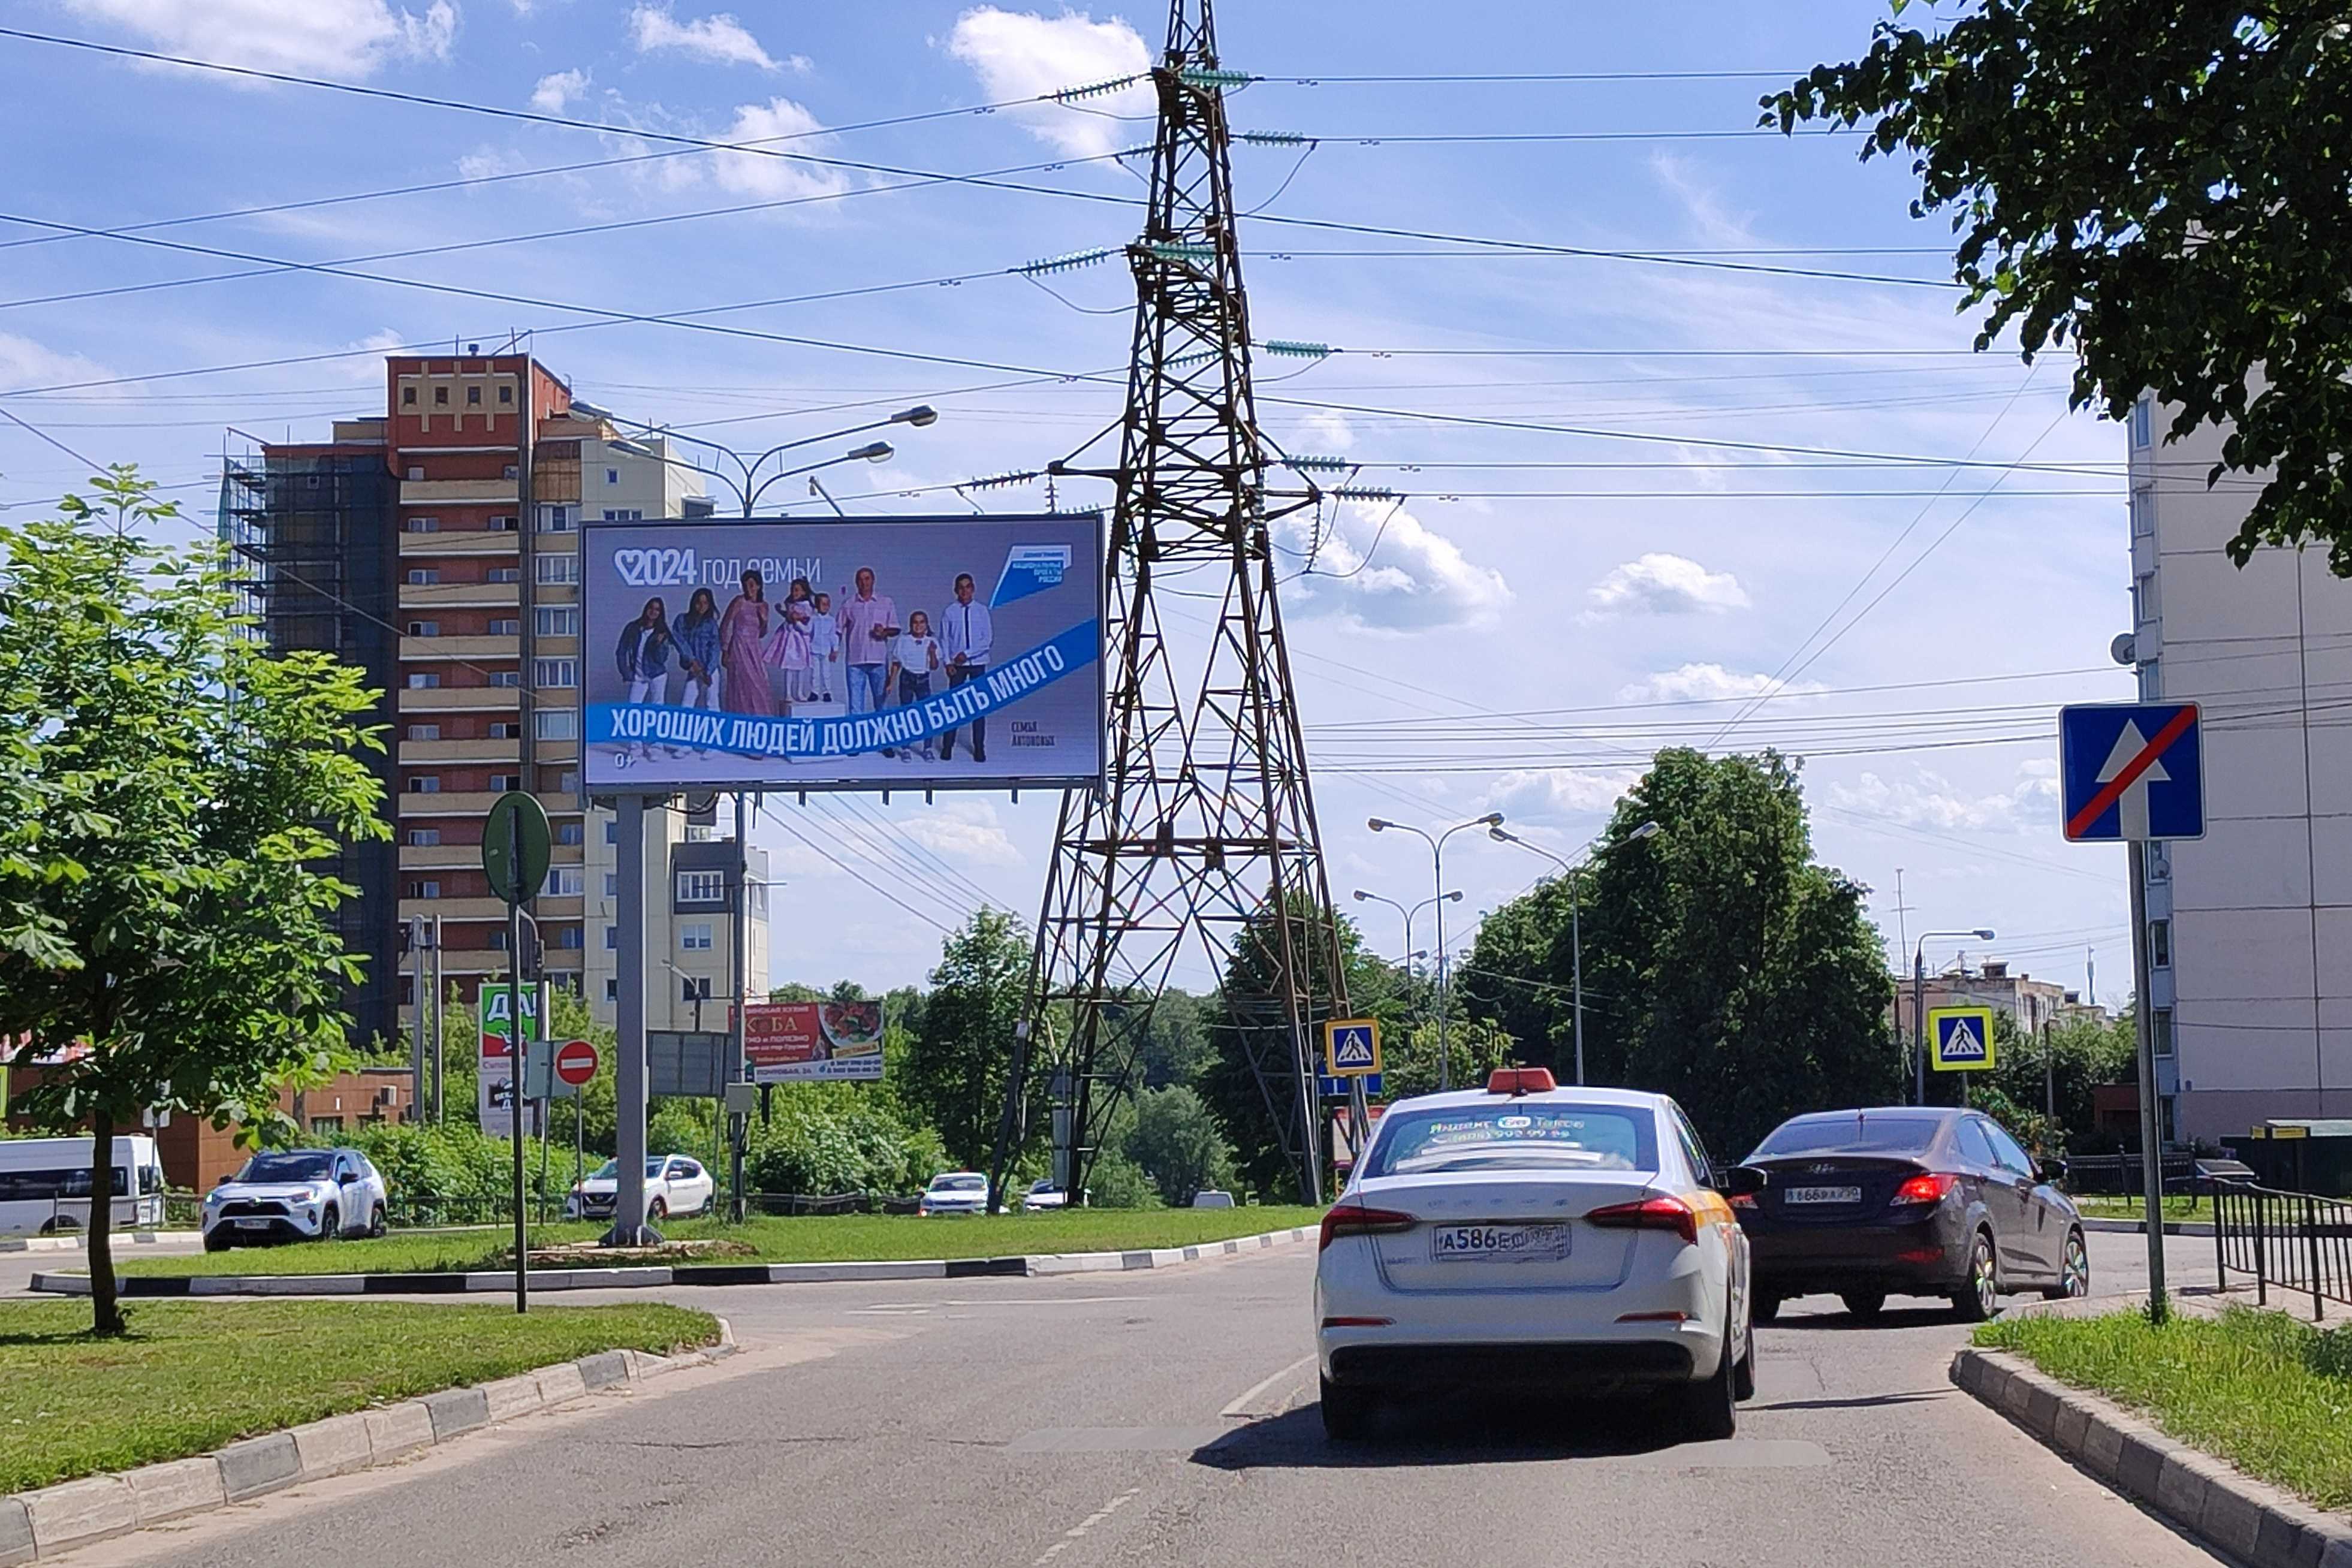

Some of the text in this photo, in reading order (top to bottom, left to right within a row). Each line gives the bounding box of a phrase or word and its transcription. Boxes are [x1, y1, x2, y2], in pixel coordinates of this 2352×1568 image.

[625, 548, 697, 586] 2024
[611, 645, 1065, 755] ХОРОШИХ ЛЮДЕЙ ДОЛЖНО БЫТЬ МНОГО
